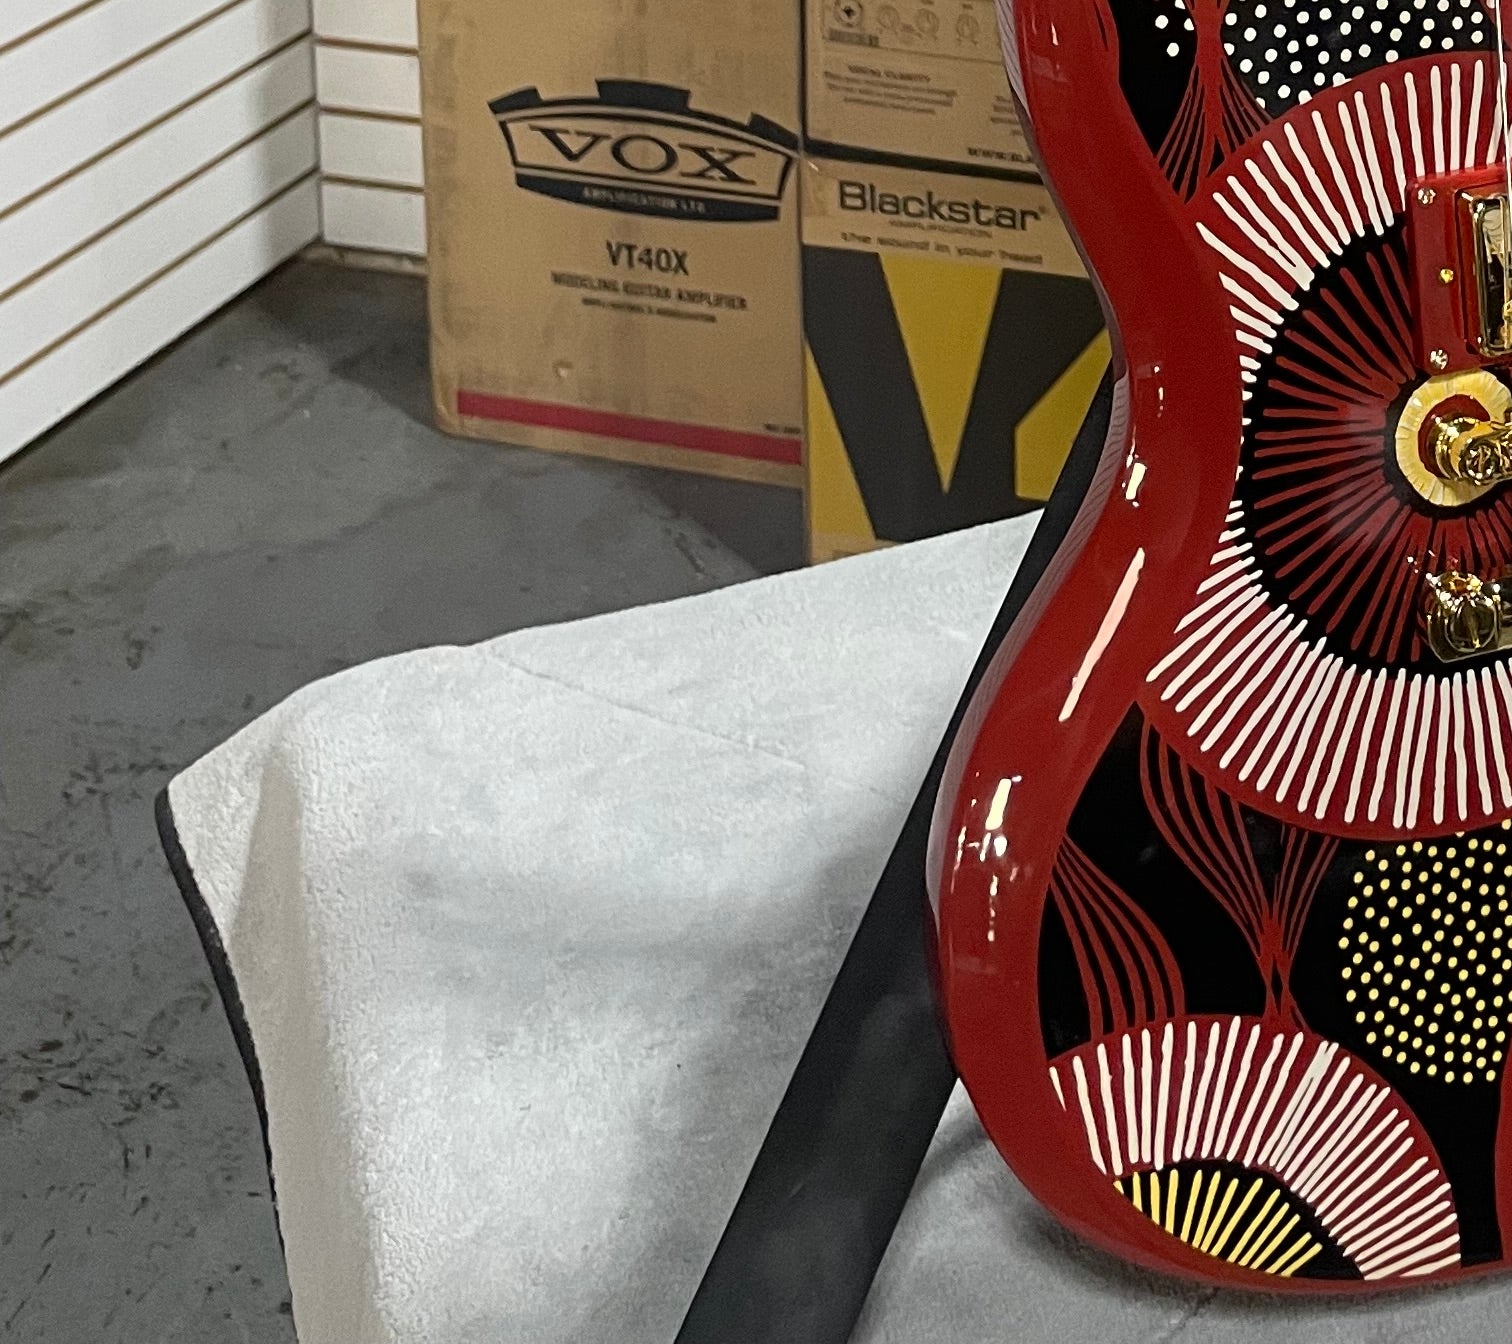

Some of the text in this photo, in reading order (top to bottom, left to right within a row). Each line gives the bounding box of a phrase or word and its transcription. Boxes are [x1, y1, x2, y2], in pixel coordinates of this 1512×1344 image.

[527, 122, 757, 186] VOX
[838, 179, 1042, 231] Blackstar
[605, 238, 690, 277] VT40X
